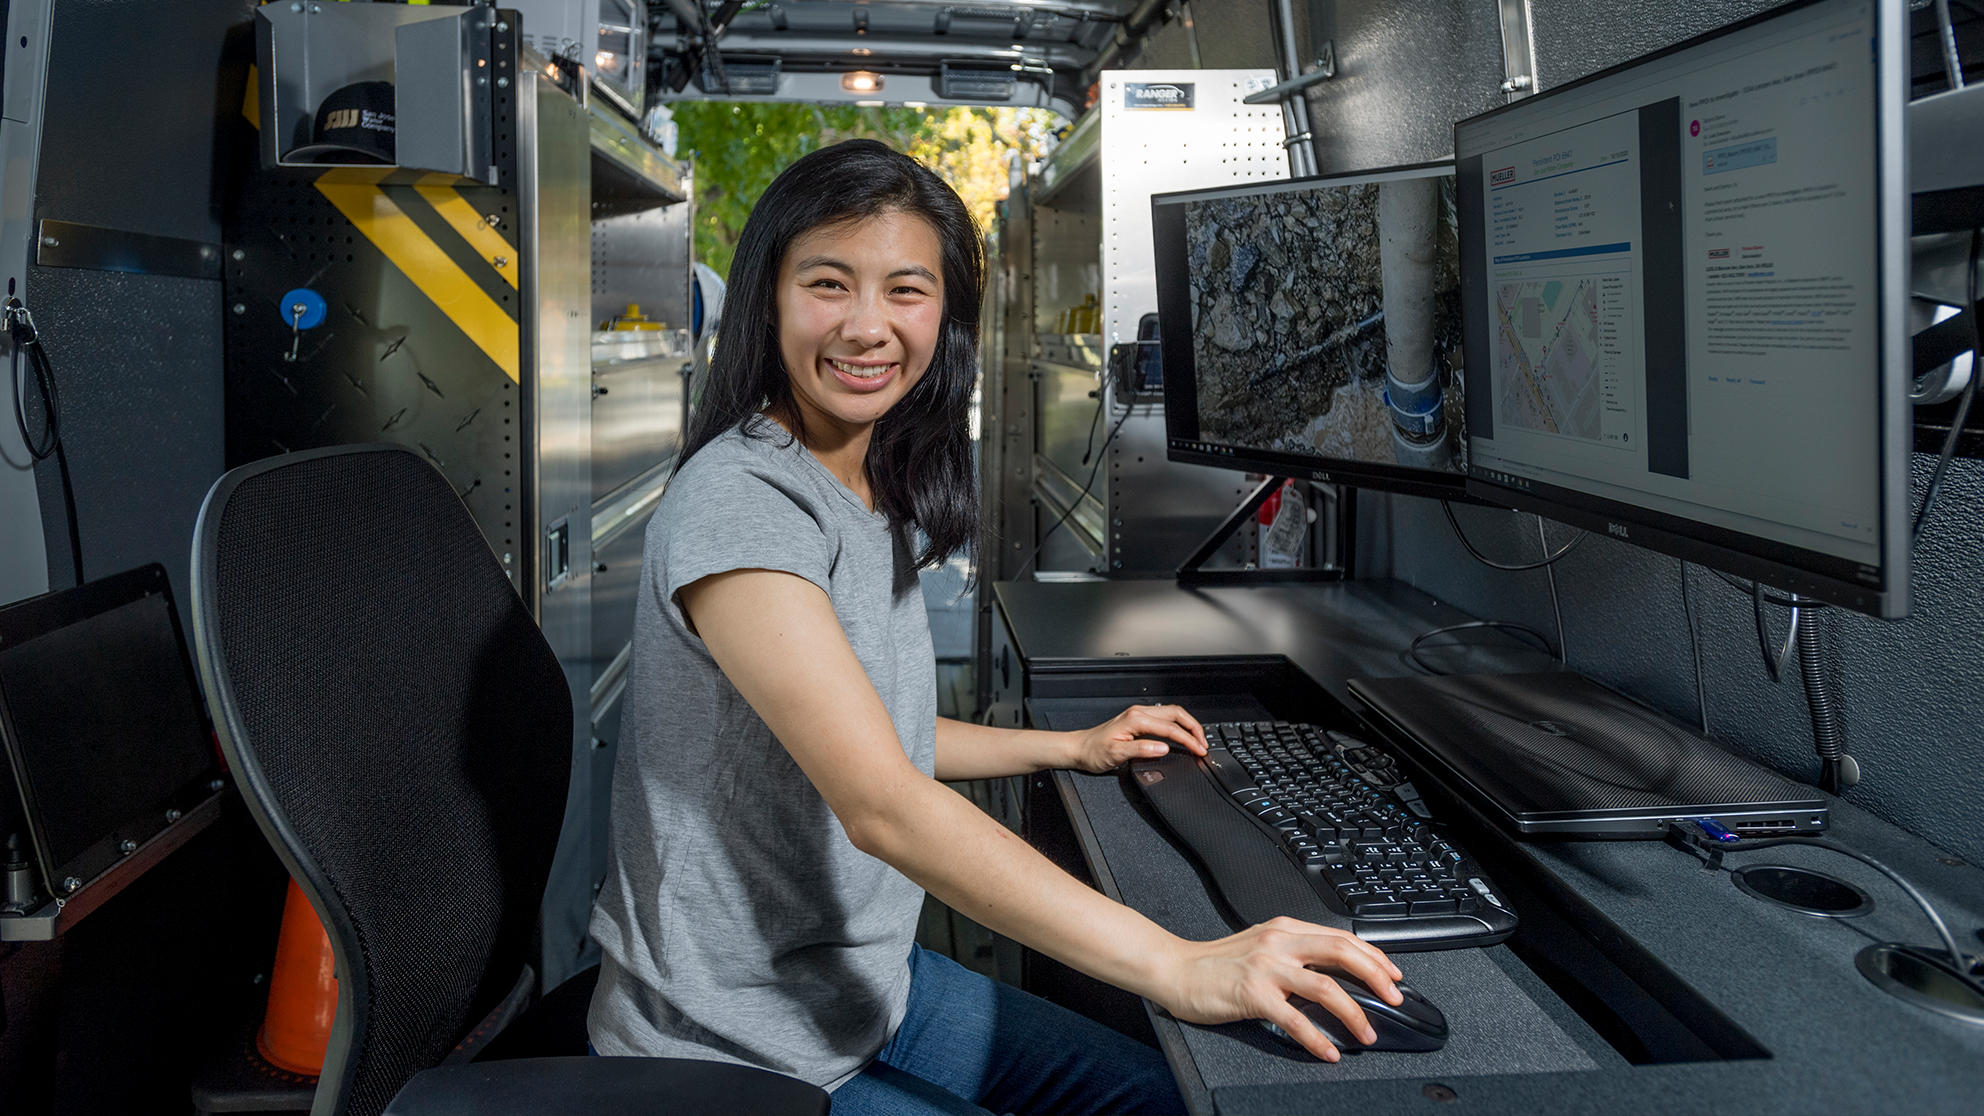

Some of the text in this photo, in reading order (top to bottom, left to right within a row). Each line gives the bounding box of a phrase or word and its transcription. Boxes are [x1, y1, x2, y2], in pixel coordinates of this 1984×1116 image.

[1136, 89, 1178, 99] RANGER
[362, 110, 376, 118] San
[1532, 150, 1573, 167] Persistent POI 6947
[1491, 169, 1514, 183] MUELLER
[1312, 472, 1330, 480] DELL
[1608, 522, 1628, 538] DELL
